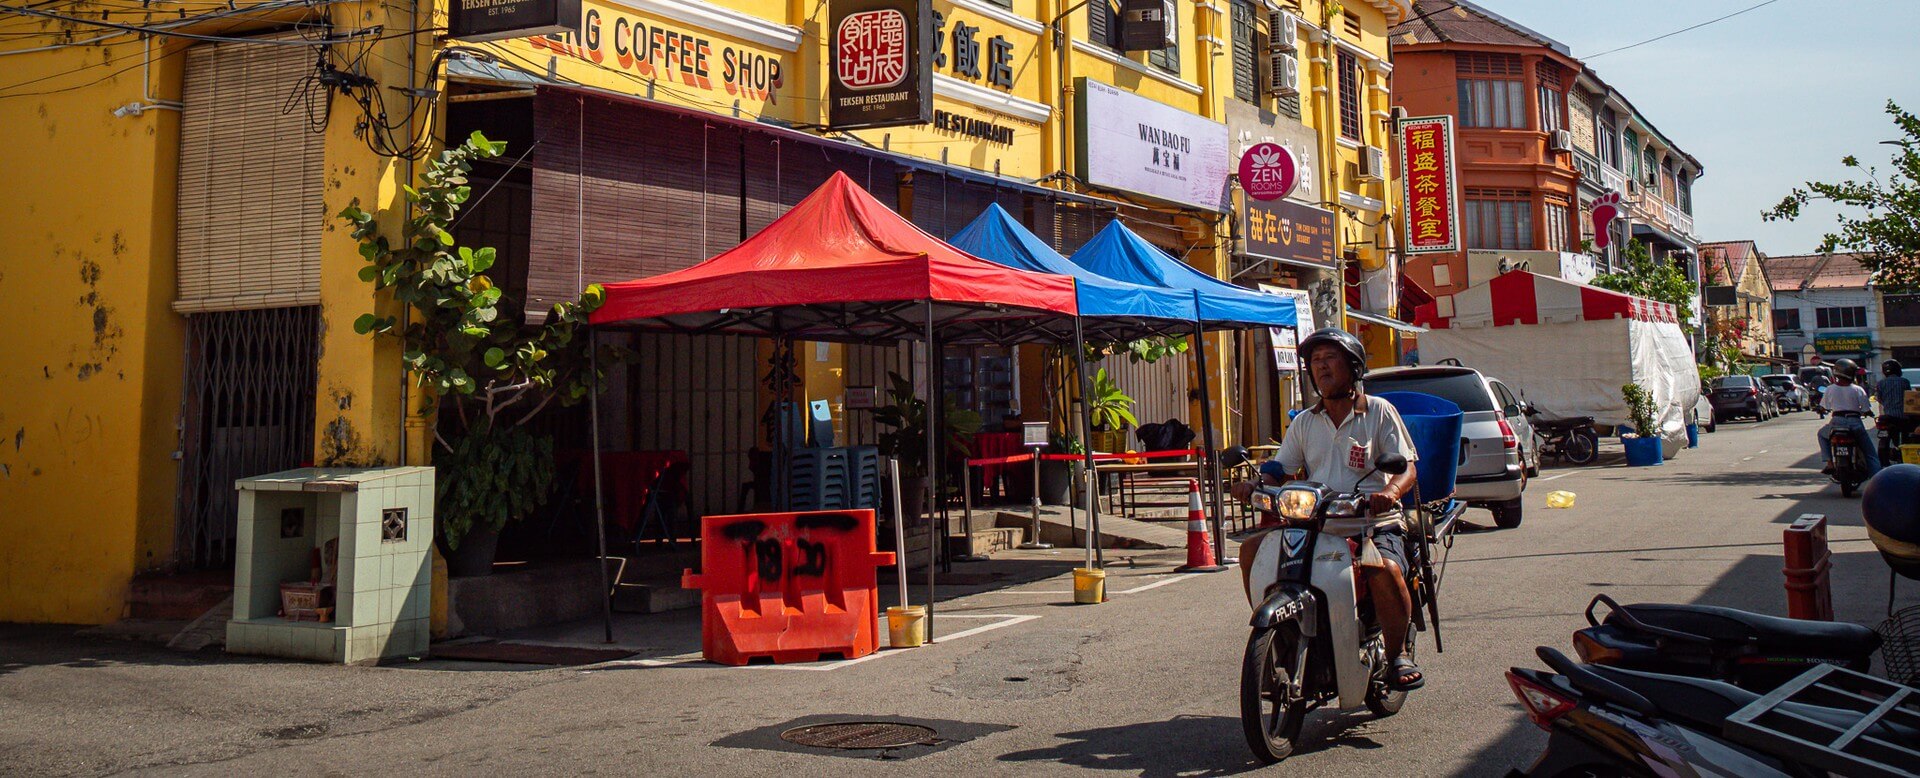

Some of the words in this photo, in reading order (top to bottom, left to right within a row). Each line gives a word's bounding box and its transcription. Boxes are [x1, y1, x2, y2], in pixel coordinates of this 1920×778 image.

[462, 0, 490, 10] TEKSEN
[501, 6, 516, 14] 1965
[614, 17, 711, 79] COFFEE
[722, 46, 782, 93] SHOP
[840, 95, 865, 107] TEKSEN
[865, 91, 909, 104] RESTAURANT
[934, 109, 1015, 146] RESTAURANT
[1138, 123, 1161, 146] WAN
[1161, 129, 1180, 151] BAO
[1180, 135, 1191, 154] FU
[1250, 168, 1283, 182] ZEN
[1250, 182, 1283, 191] ROOMS
[1412, 129, 1443, 239] 福盛茶餐室
[1806, 657, 1841, 665] HONDA
